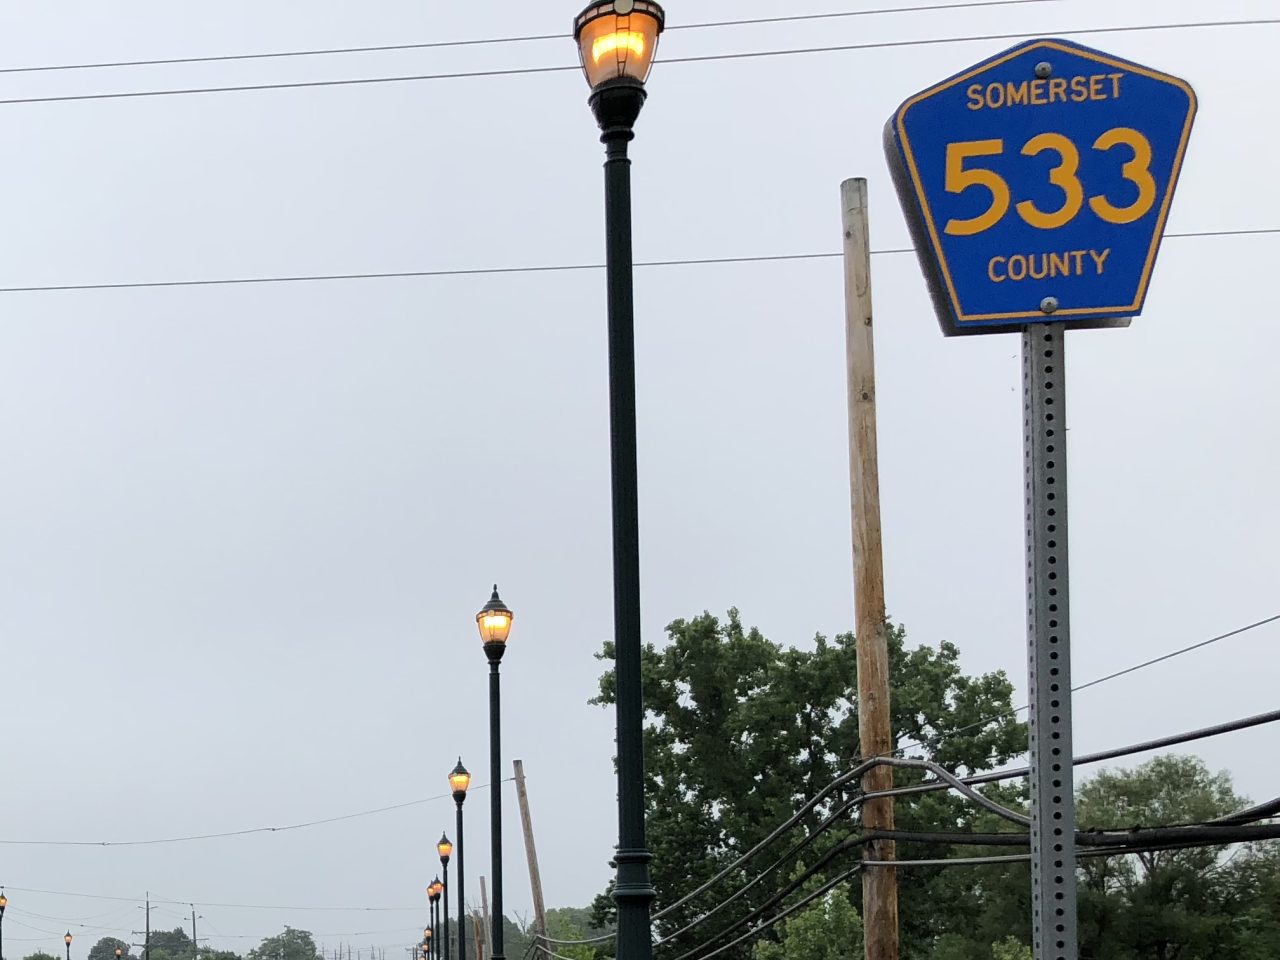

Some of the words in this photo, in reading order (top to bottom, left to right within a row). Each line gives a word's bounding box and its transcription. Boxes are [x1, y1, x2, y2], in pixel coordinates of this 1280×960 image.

[966, 73, 1124, 111] SOMERSET
[943, 127, 1157, 236] 533
[987, 248, 1111, 283] COUNTY
